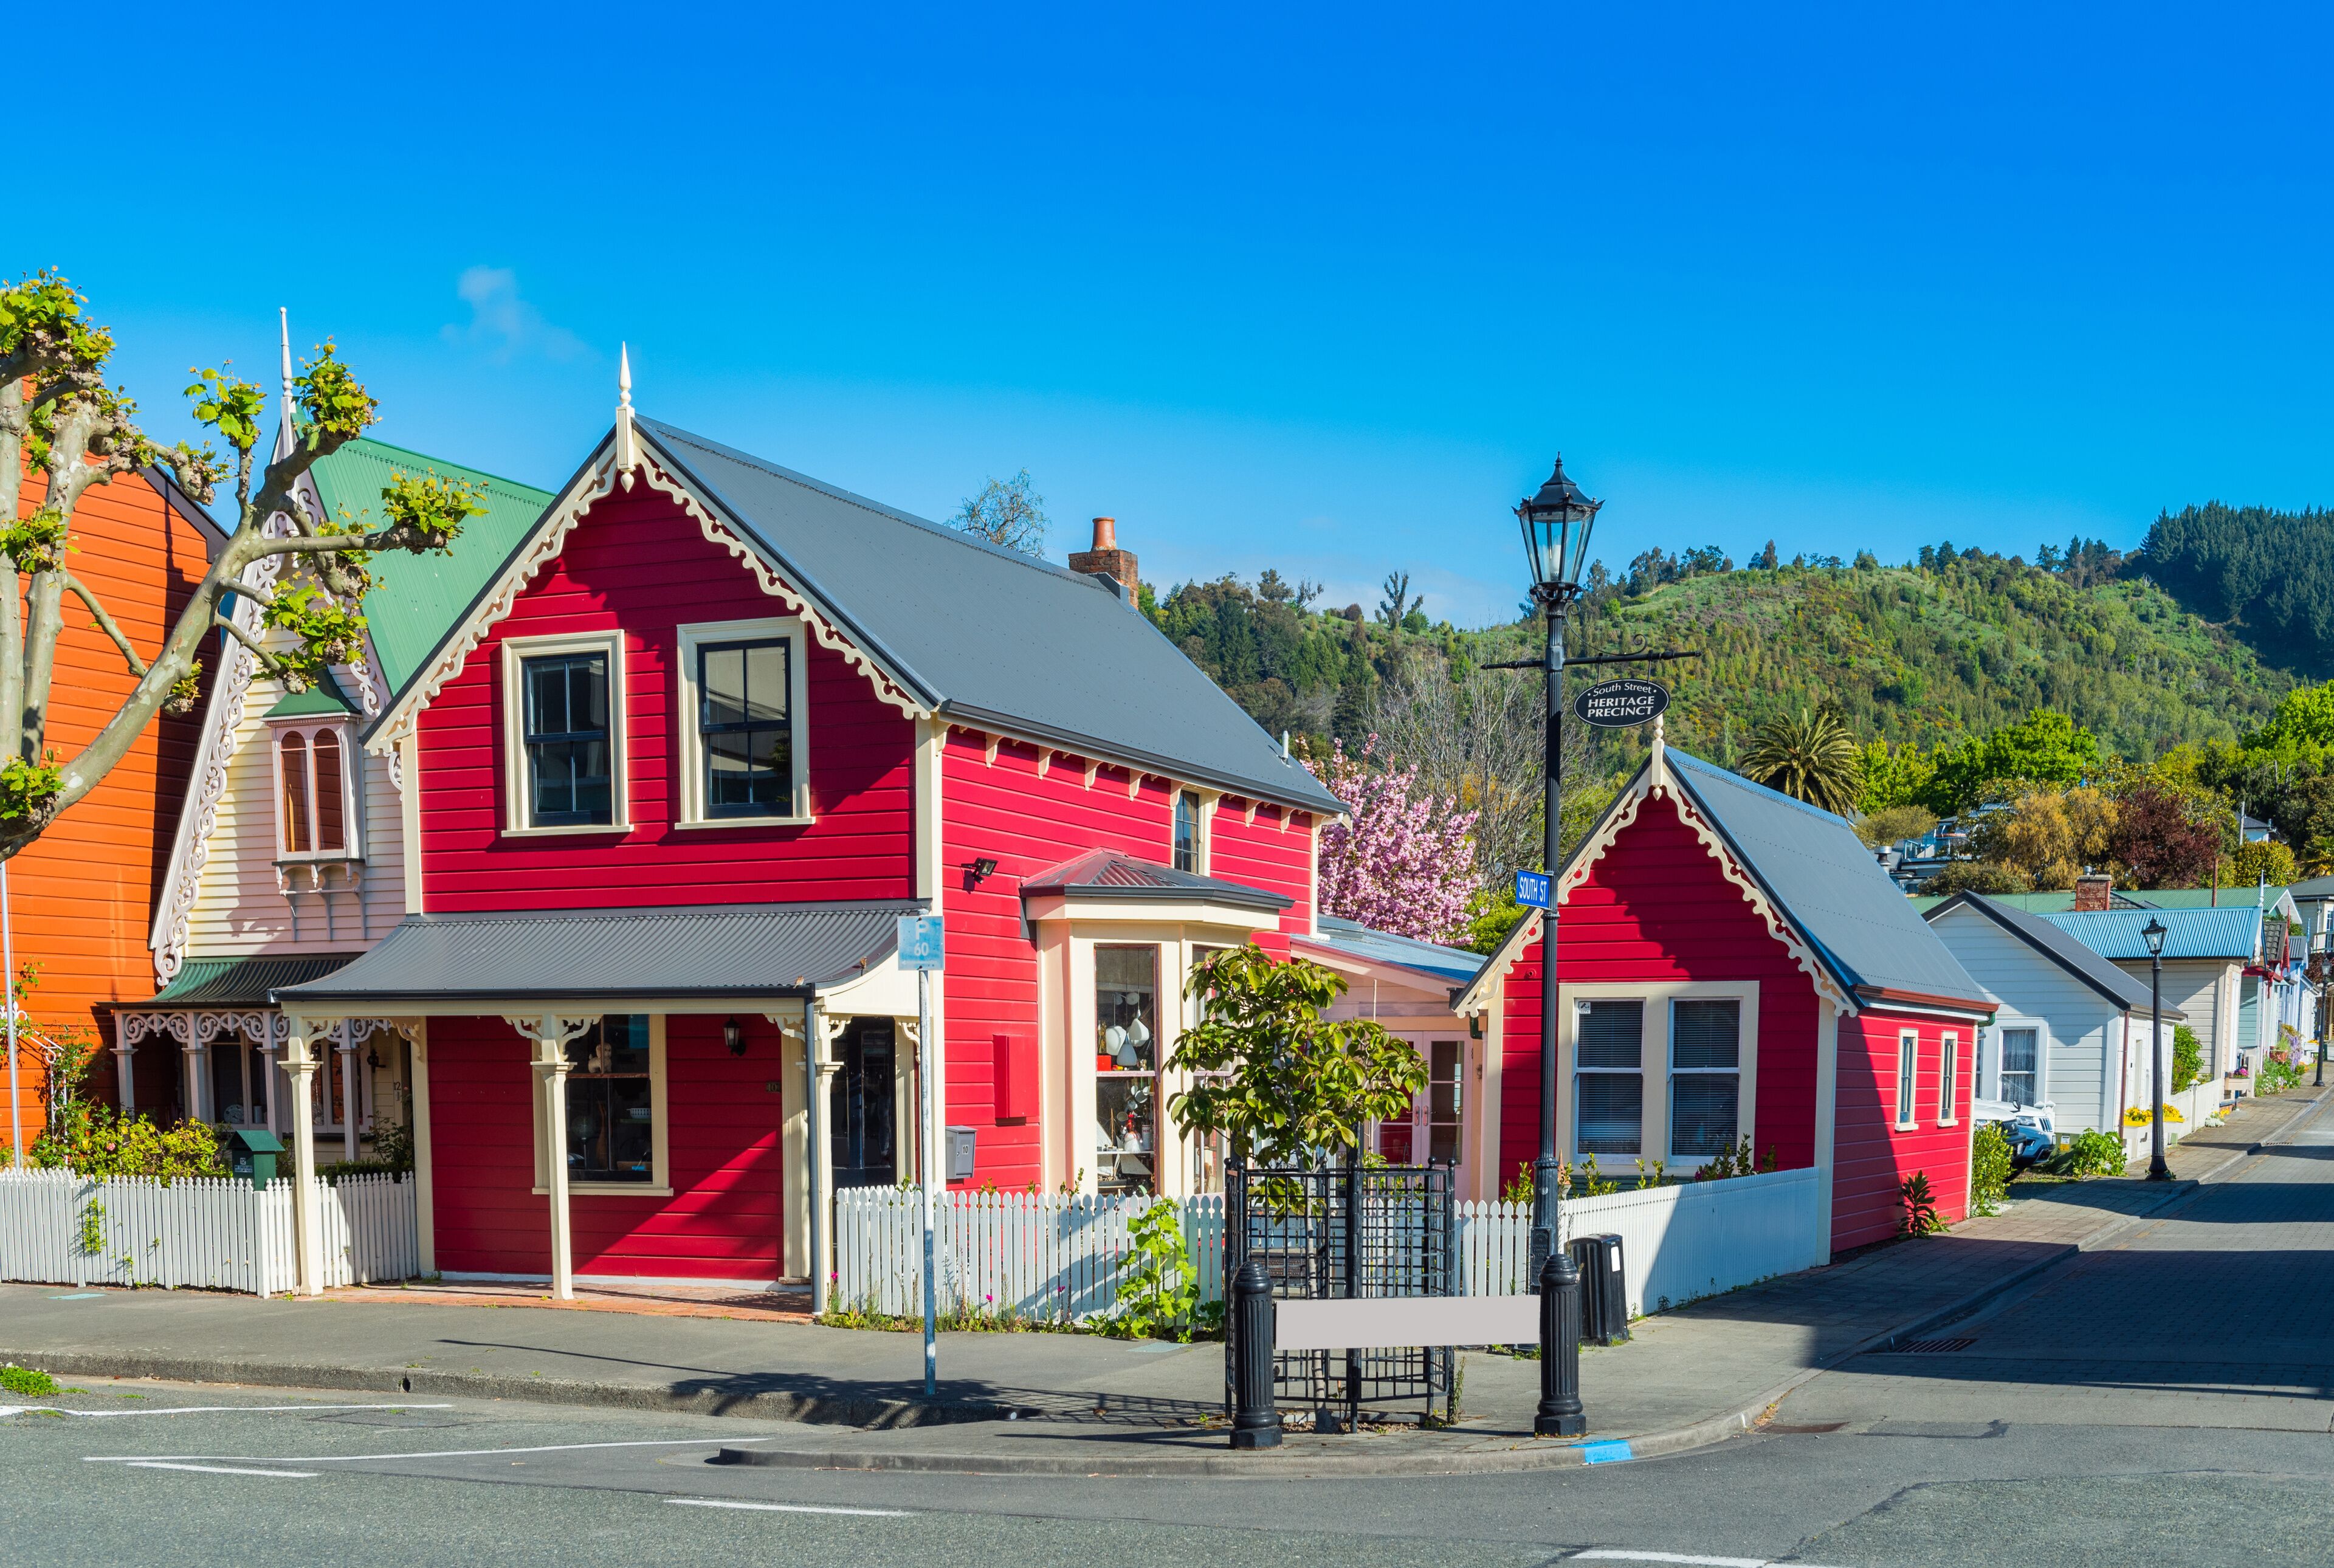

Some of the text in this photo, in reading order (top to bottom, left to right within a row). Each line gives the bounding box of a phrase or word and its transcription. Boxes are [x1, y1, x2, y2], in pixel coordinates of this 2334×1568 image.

[1593, 683, 1652, 696] South Street
[1588, 696, 1654, 707] HERITAGE
[1588, 706, 1654, 718] PRECINCT
[1519, 876, 1547, 903] SOUTH ST
[915, 920, 929, 940] P
[914, 942, 929, 956] 60
[393, 1081, 401, 1090] 12
[963, 1145, 968, 1154] 10
